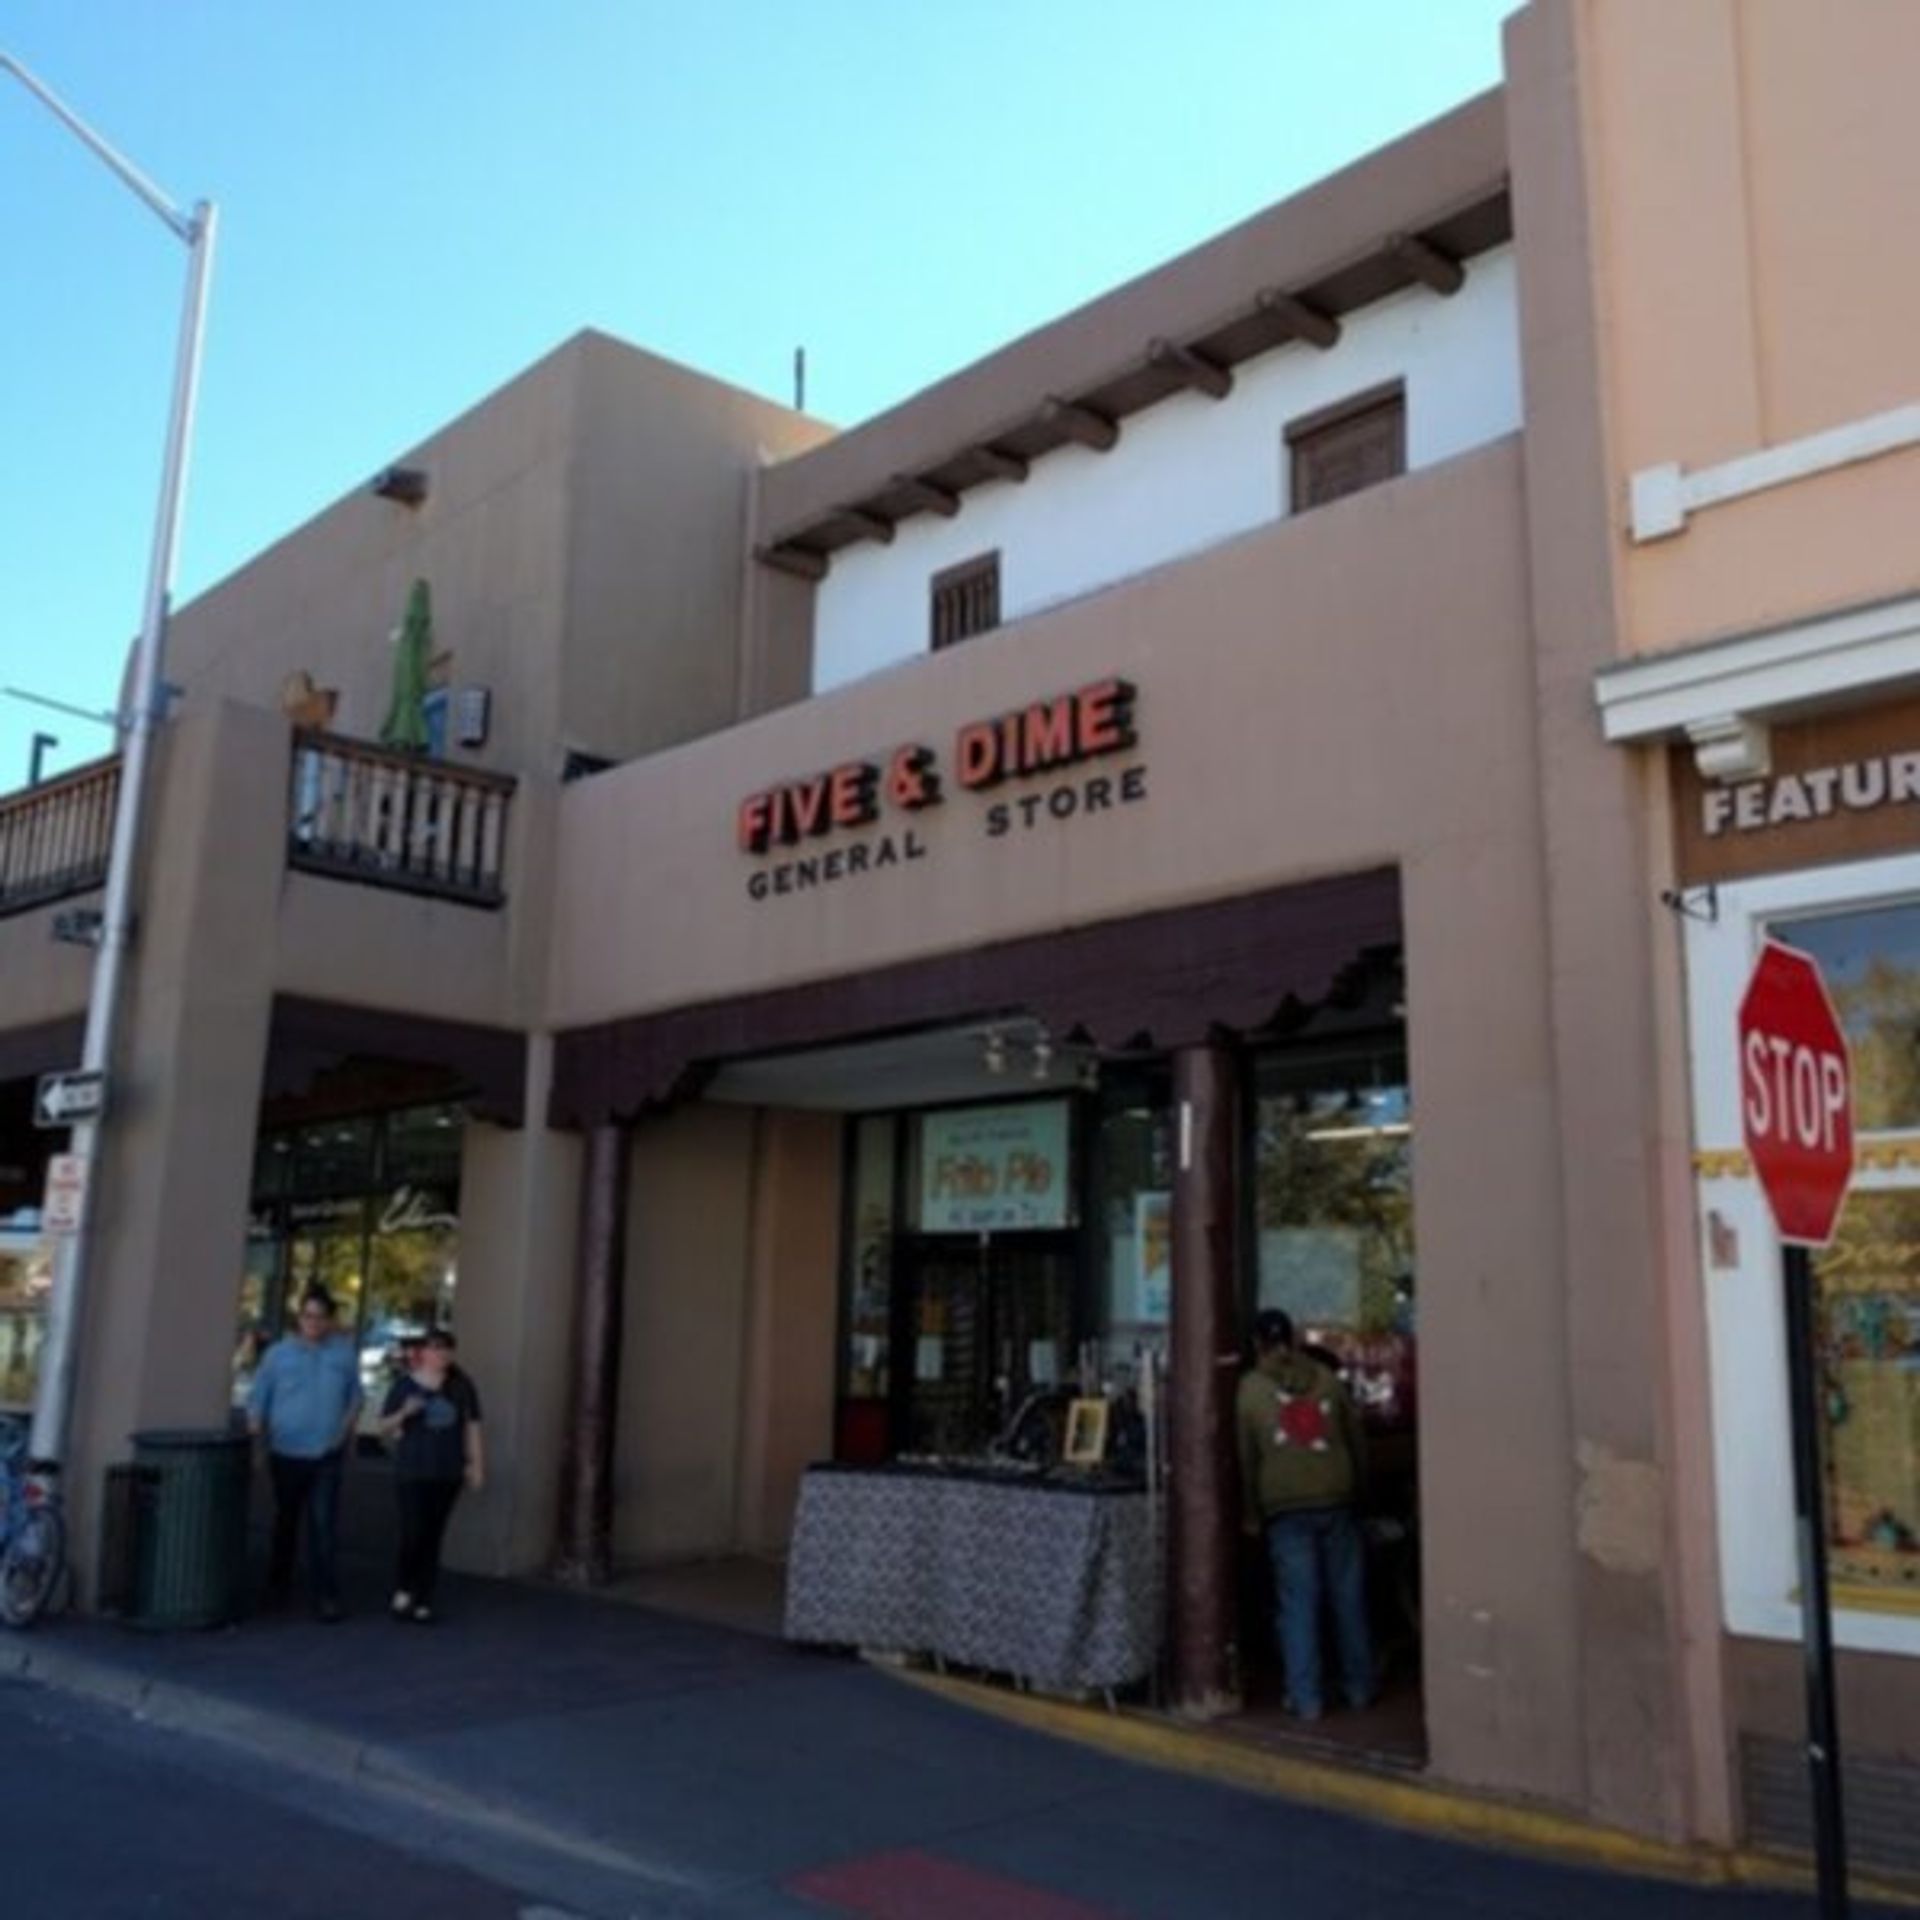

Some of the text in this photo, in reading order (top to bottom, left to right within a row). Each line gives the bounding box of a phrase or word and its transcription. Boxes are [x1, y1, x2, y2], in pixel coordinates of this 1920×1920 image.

[739, 678, 1134, 853] FIVE & DIME
[747, 767, 1147, 899] GENERAL STORE
[1746, 1028, 1845, 1151] STOP
